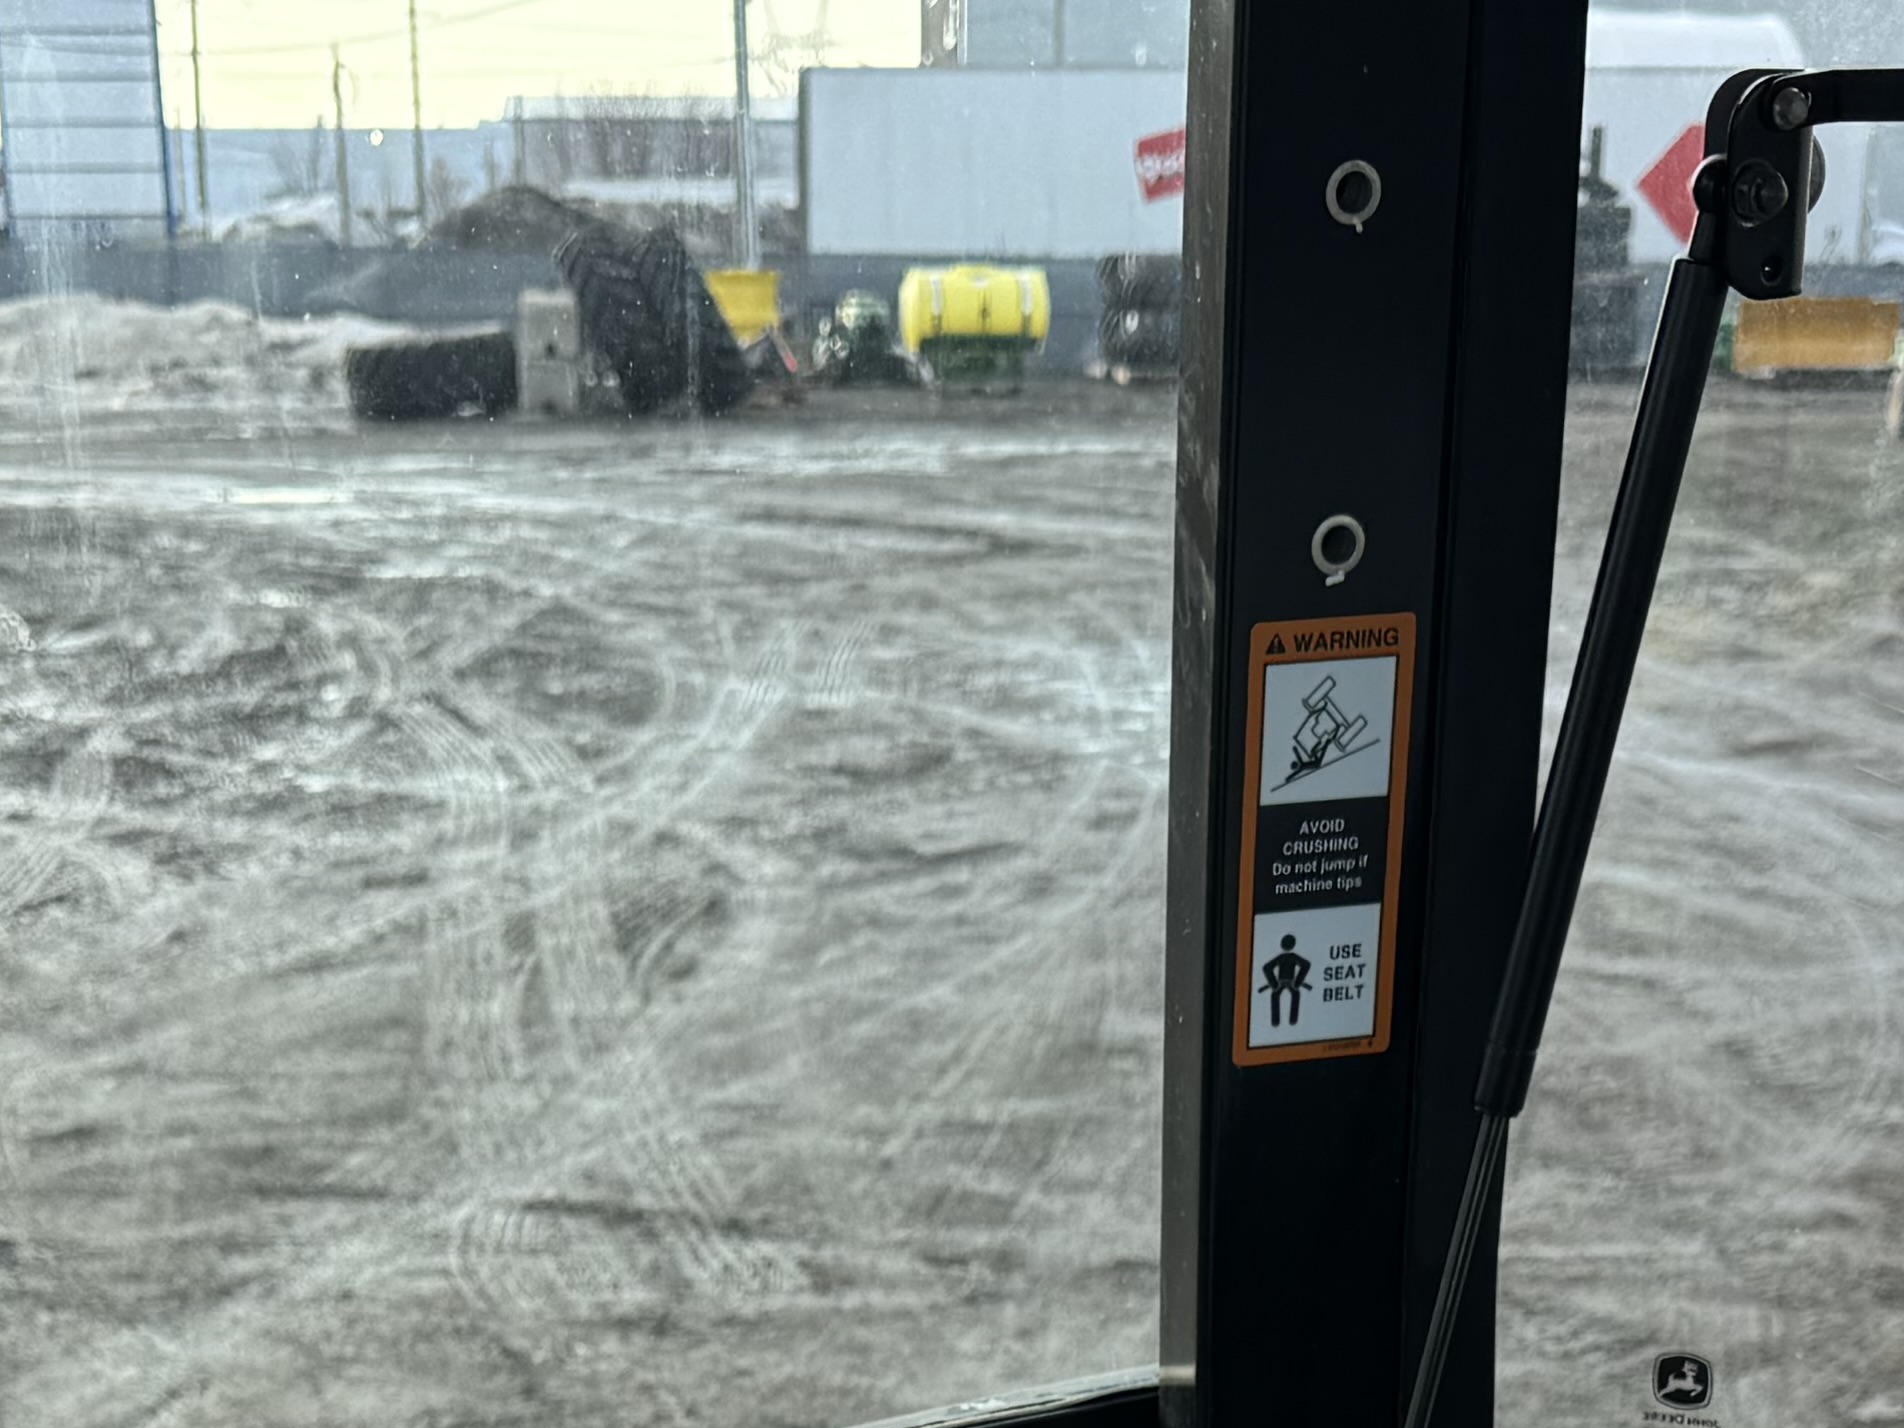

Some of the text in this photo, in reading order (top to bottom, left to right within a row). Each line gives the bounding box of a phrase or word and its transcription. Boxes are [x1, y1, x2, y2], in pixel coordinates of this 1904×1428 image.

[1293, 628, 1399, 651] WARNING
[1300, 819, 1345, 835] AVOID
[1283, 837, 1359, 855] CRUSHING
[1273, 854, 1368, 876] Do not jump if
[1276, 877, 1362, 895] machine tips
[1329, 944, 1362, 960] USE
[1323, 963, 1367, 981] SEAT
[1323, 985, 1365, 1002] BELT
